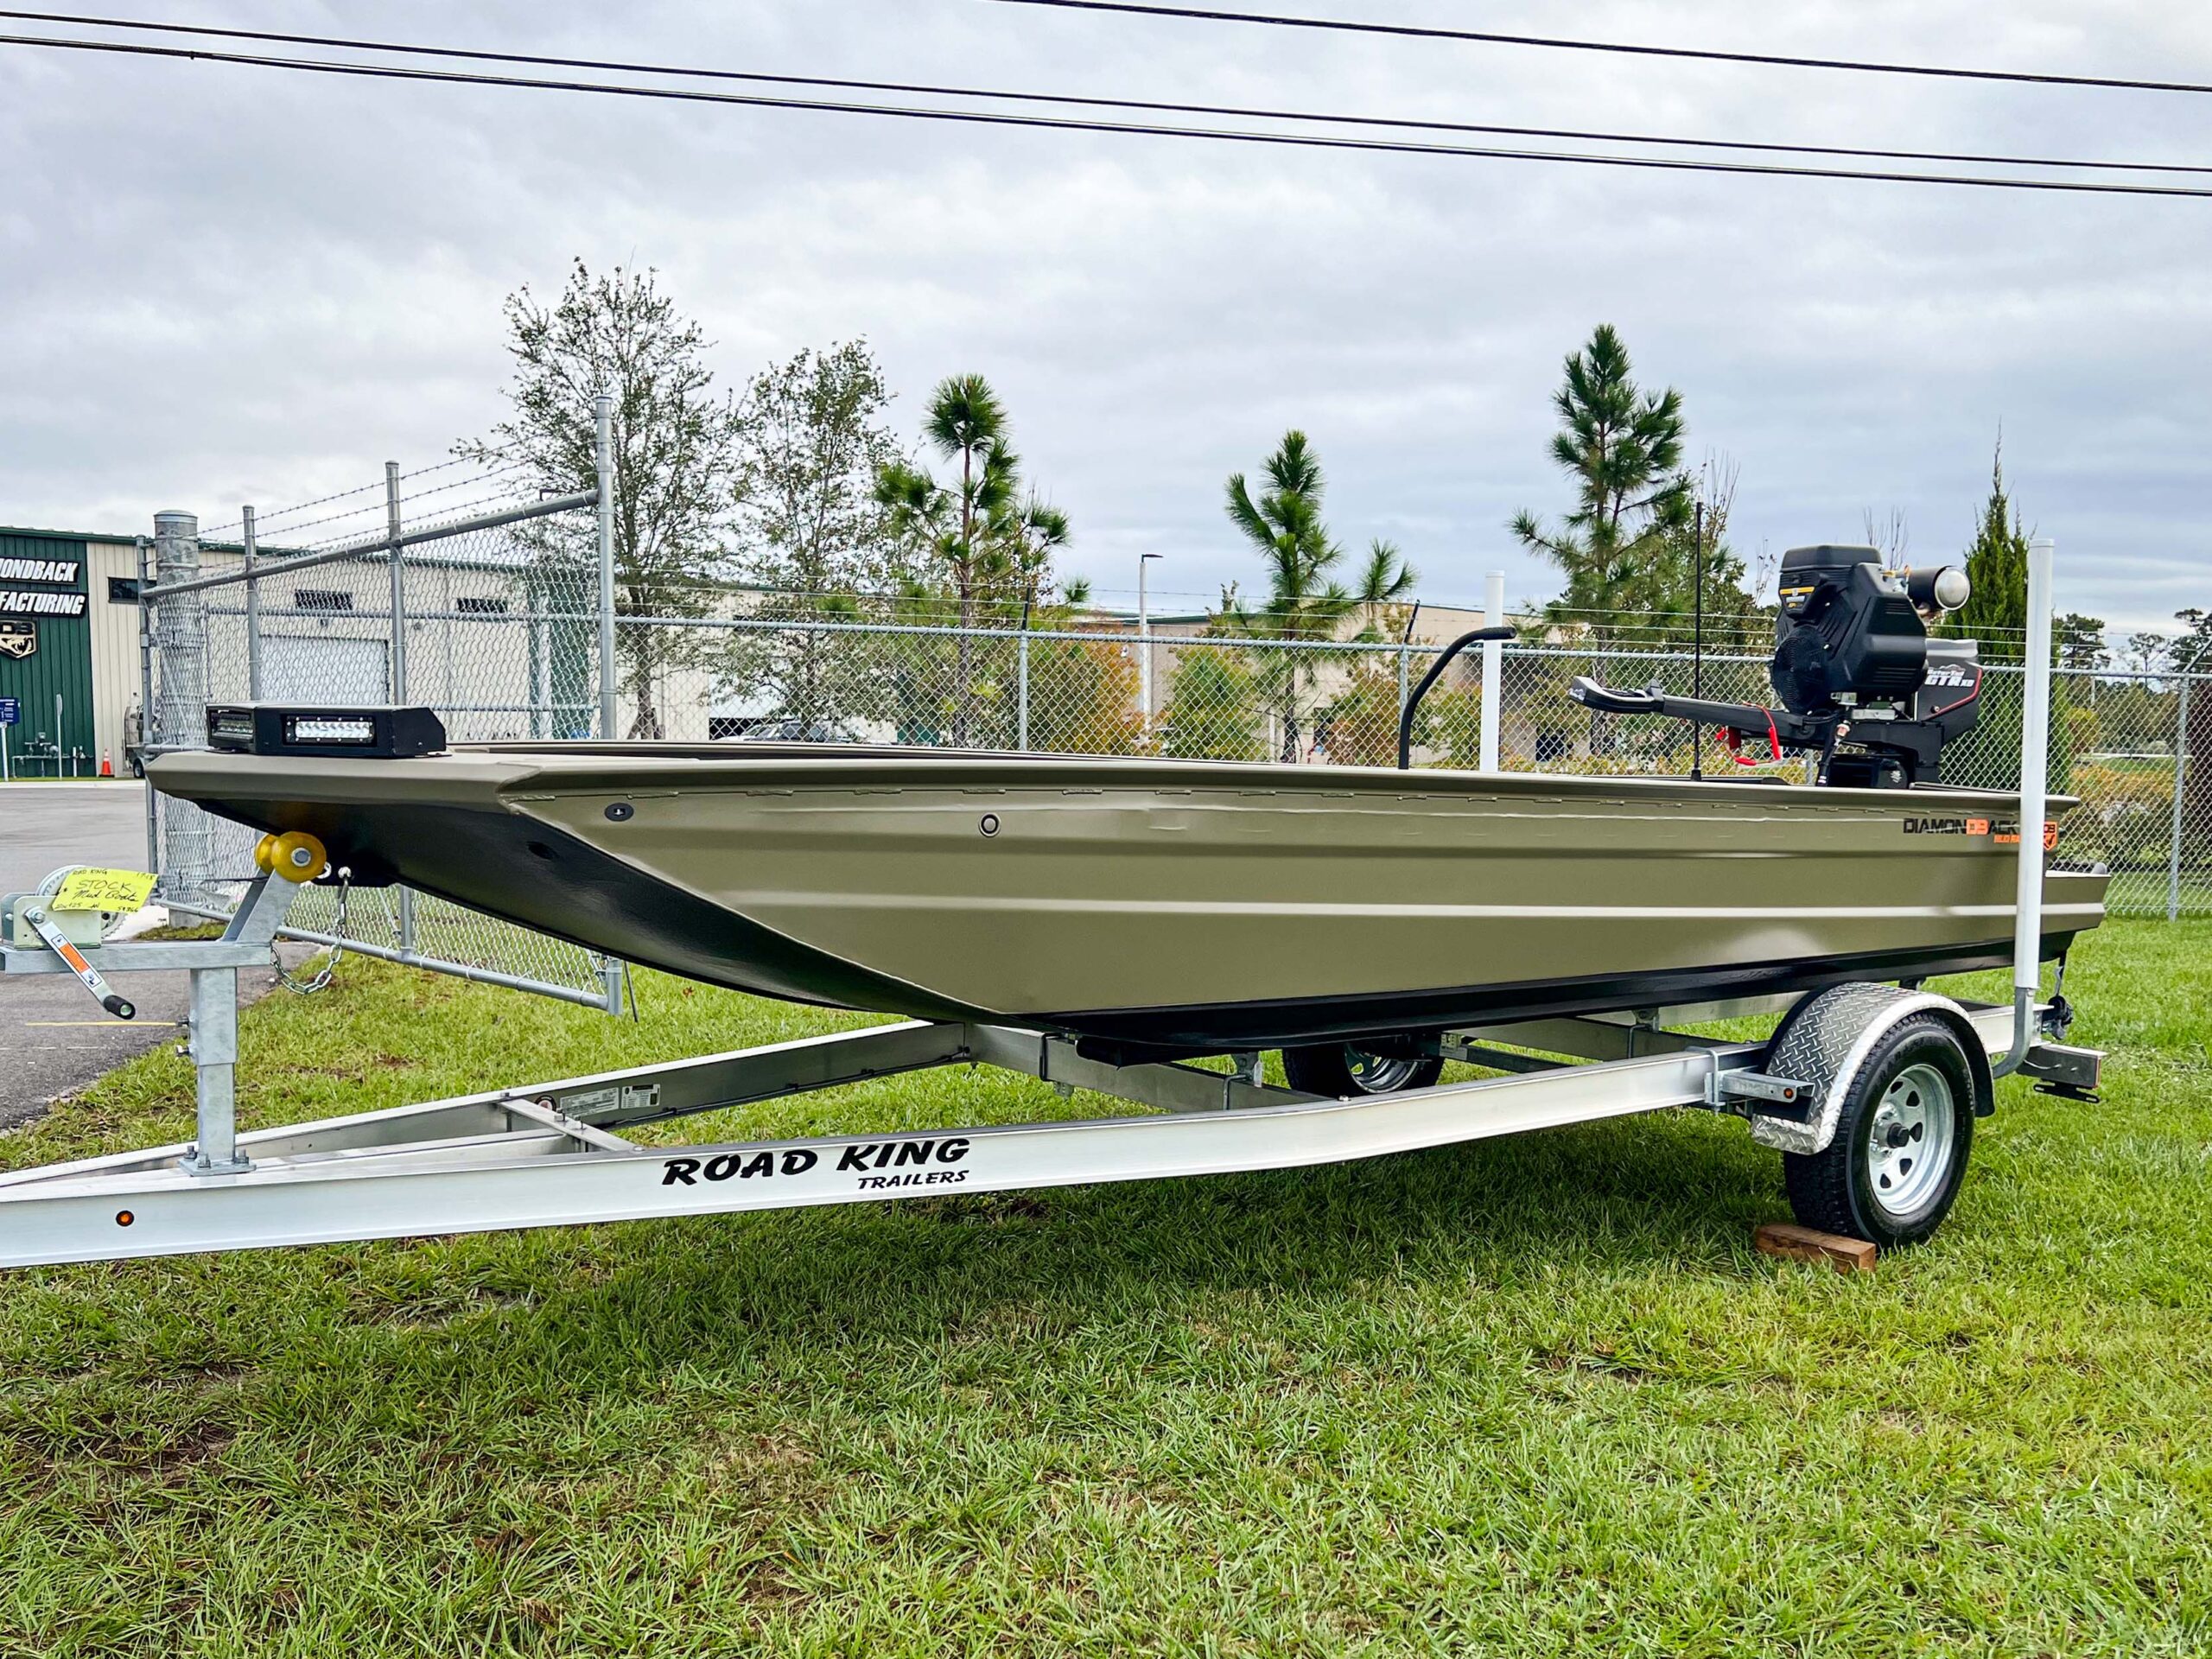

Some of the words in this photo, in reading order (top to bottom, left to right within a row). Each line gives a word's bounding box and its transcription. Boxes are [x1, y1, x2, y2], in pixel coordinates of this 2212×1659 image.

[72, 889, 102, 899] Mud
[76, 880, 131, 893] STOCK
[662, 1150, 818, 1185] ROAD
[836, 1138, 970, 1172] KING
[857, 1170, 970, 1190] TRAILERS
